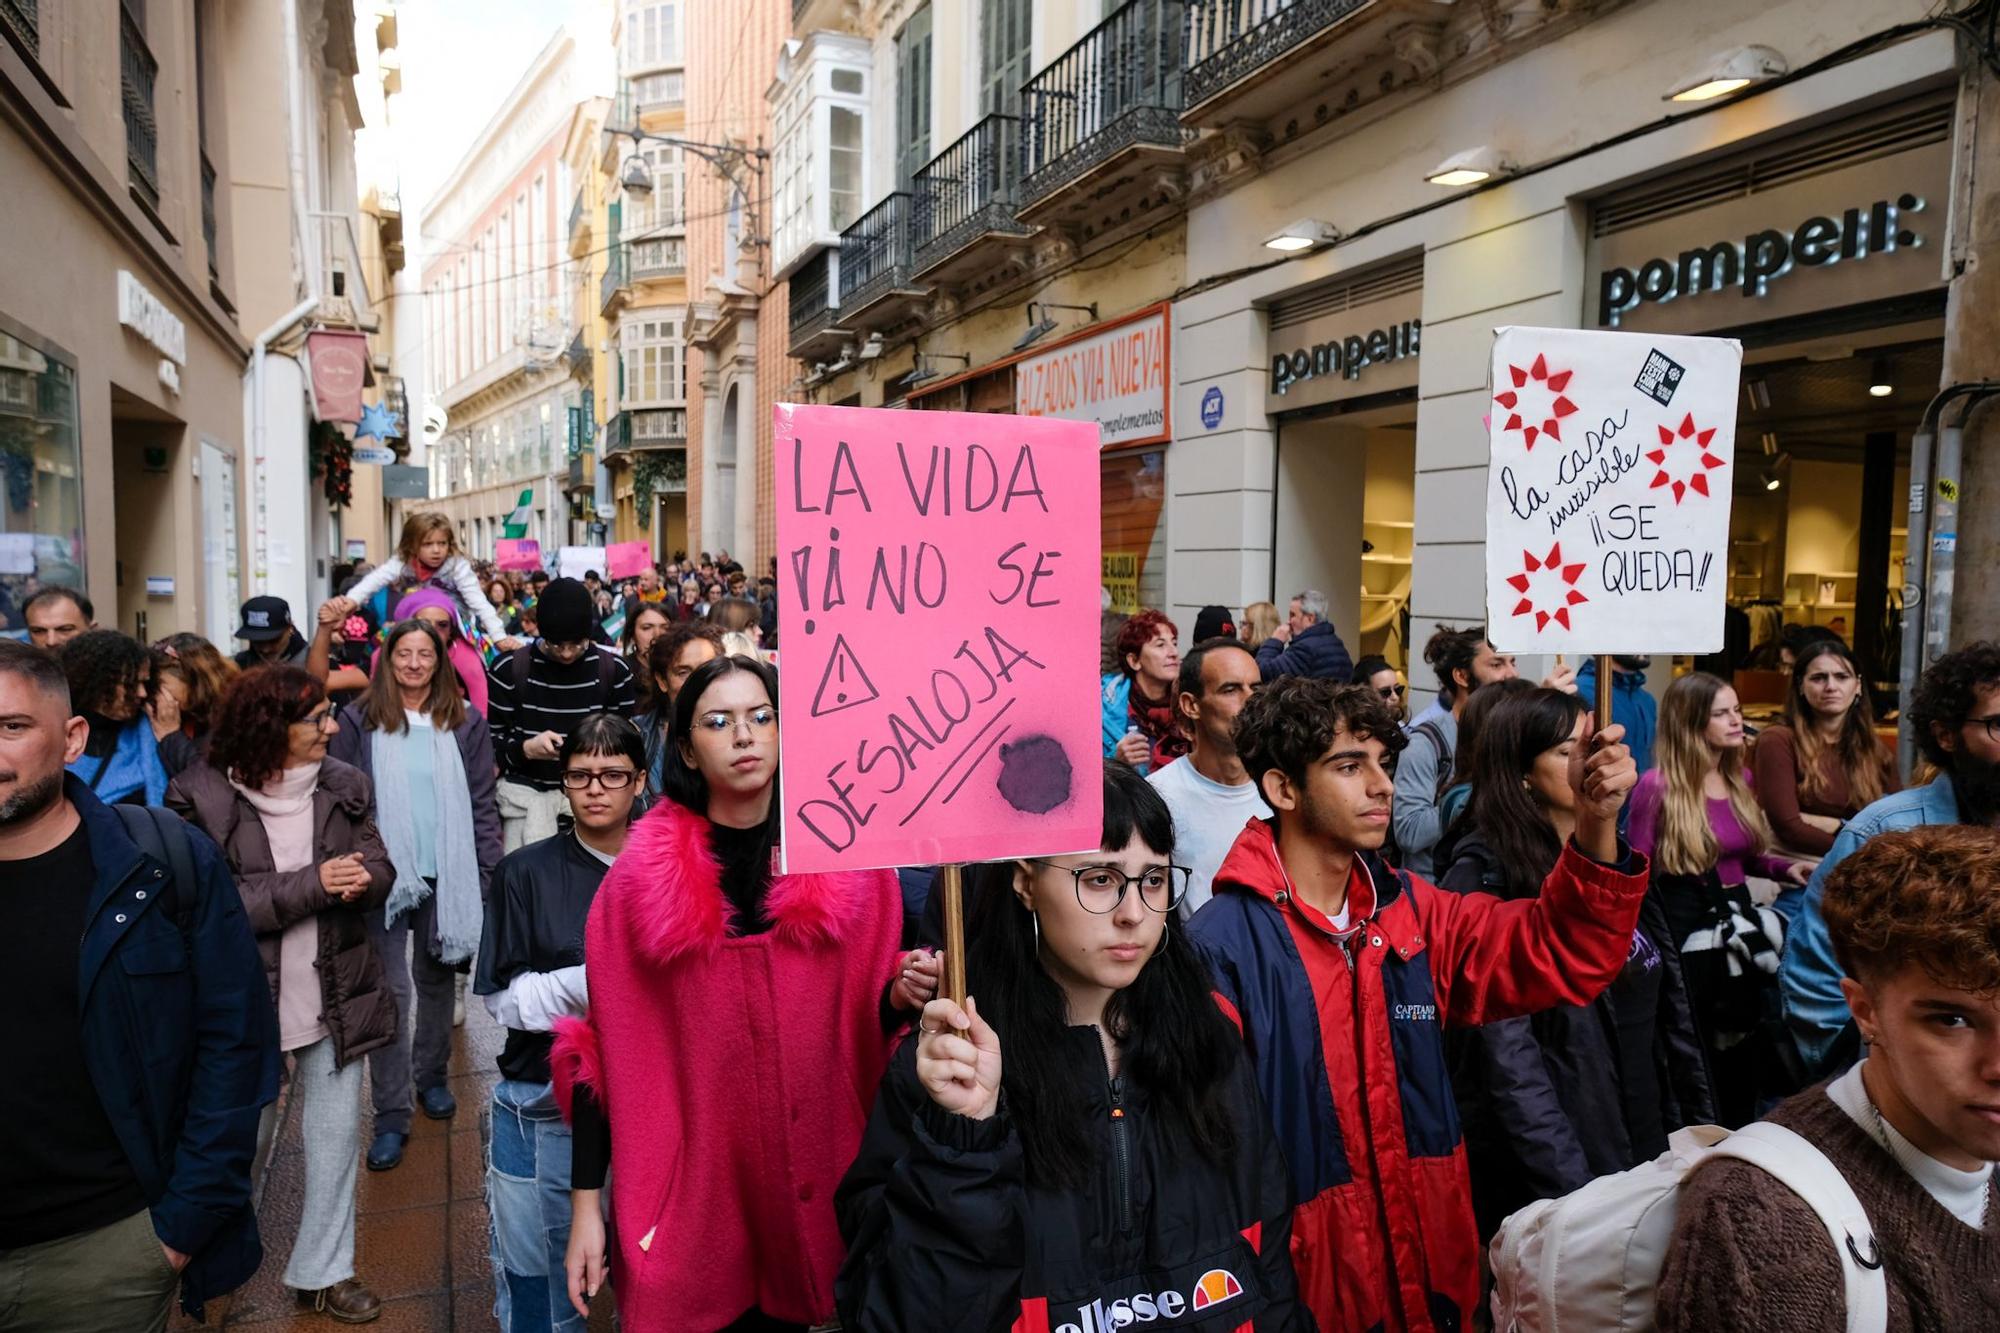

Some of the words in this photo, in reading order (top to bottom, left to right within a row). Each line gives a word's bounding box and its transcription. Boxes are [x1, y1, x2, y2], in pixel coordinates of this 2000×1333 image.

[1017, 352, 1077, 416] ALZADOS
[1081, 344, 1105, 406] VIA
[1109, 324, 1163, 399] NUEVA
[1644, 362, 1665, 383] FESTA
[794, 438, 872, 516] LA
[896, 442, 1049, 516] VIDA
[1501, 466, 1549, 521] la
[1555, 409, 1628, 486] casa
[1545, 443, 1640, 535] invisible
[989, 542, 1062, 608] SE
[1602, 549, 1713, 596] QUEDA!!
[797, 626, 1046, 853] DESALOJA
